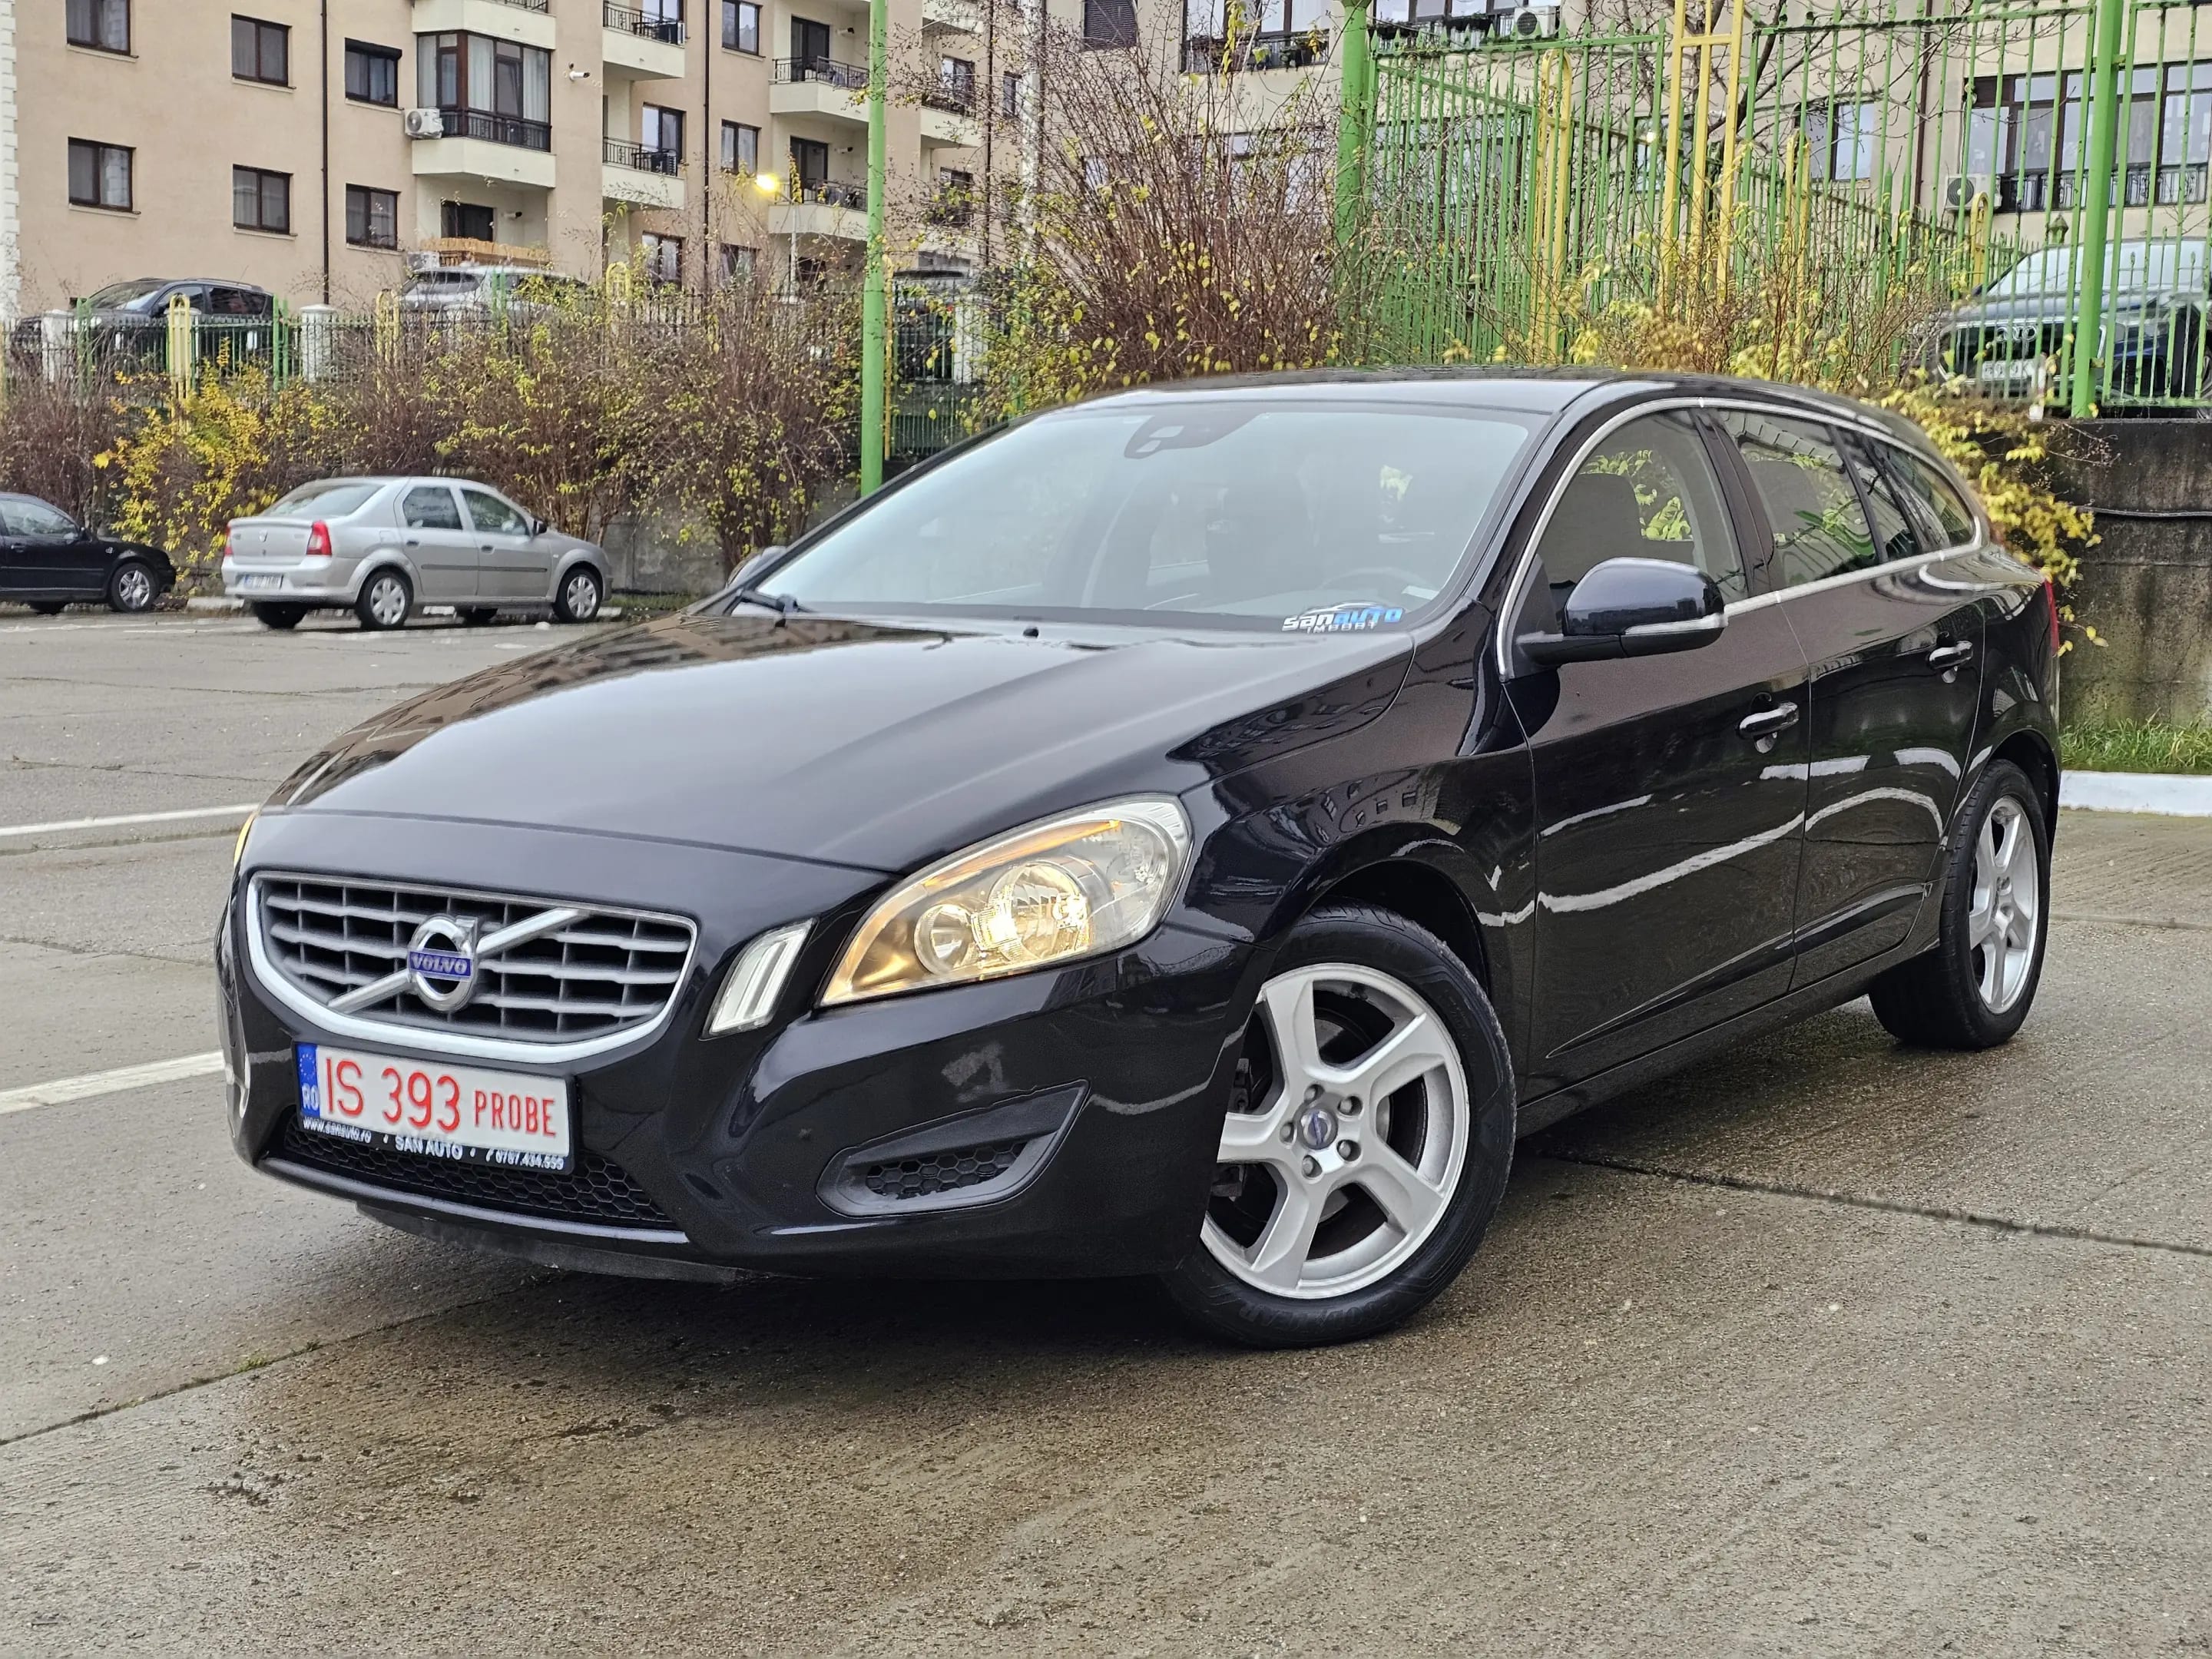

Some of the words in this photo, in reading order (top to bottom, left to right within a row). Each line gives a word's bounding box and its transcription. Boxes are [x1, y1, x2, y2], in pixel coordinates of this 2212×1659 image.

[411, 953, 468, 975] VOLVO
[301, 1083, 320, 1111] RO
[326, 1058, 364, 1117] IS
[382, 1066, 461, 1134] 393
[474, 1089, 556, 1137] PROBE
[395, 1134, 423, 1154] SAN
[425, 1137, 463, 1161] AUTO
